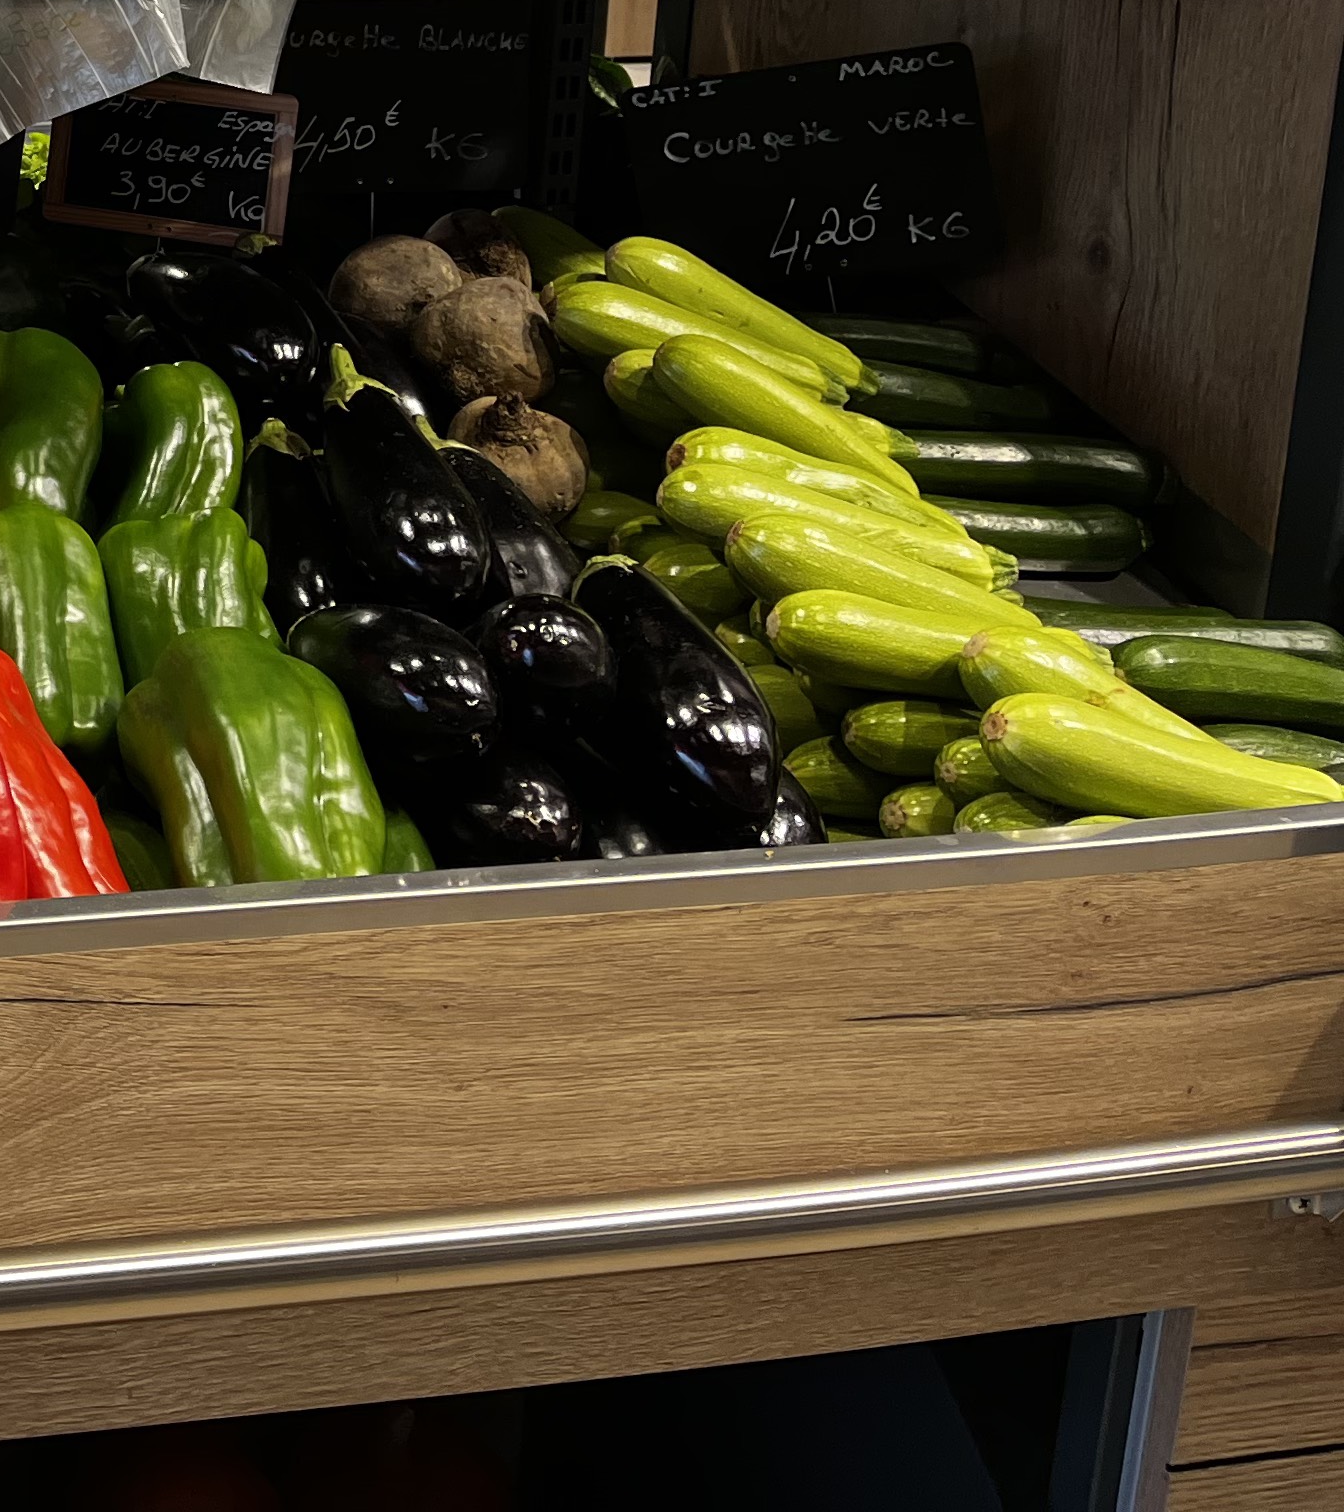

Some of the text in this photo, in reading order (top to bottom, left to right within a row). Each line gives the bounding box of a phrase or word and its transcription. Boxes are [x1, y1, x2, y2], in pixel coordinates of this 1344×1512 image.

[839, 50, 954, 82] MAROC
[110, 170, 206, 211] 3,90€
[907, 210, 970, 244] KG
